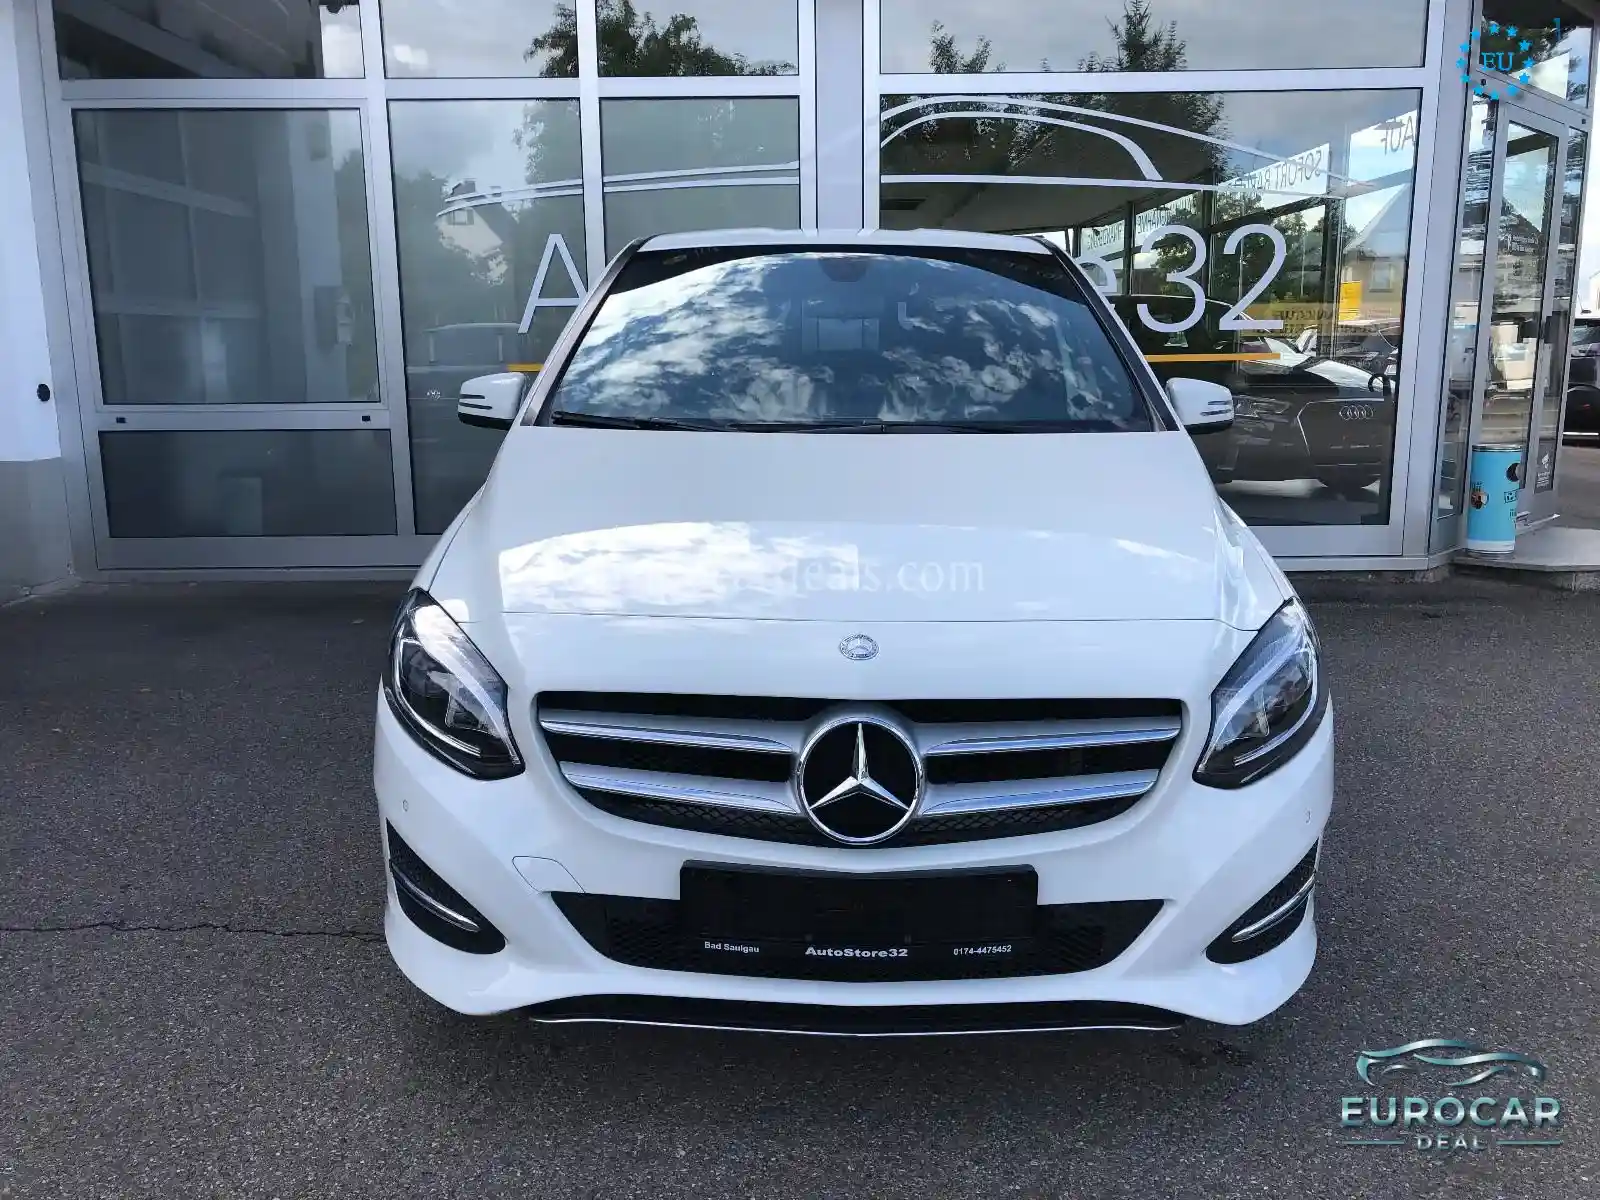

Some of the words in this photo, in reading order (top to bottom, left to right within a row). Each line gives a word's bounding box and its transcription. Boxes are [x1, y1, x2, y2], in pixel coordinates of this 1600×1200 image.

[704, 941, 722, 950] Bad
[723, 943, 760, 954] Saulgau
[805, 946, 909, 958] AutoStore32
[953, 945, 1012, 956] 0174-4475452
